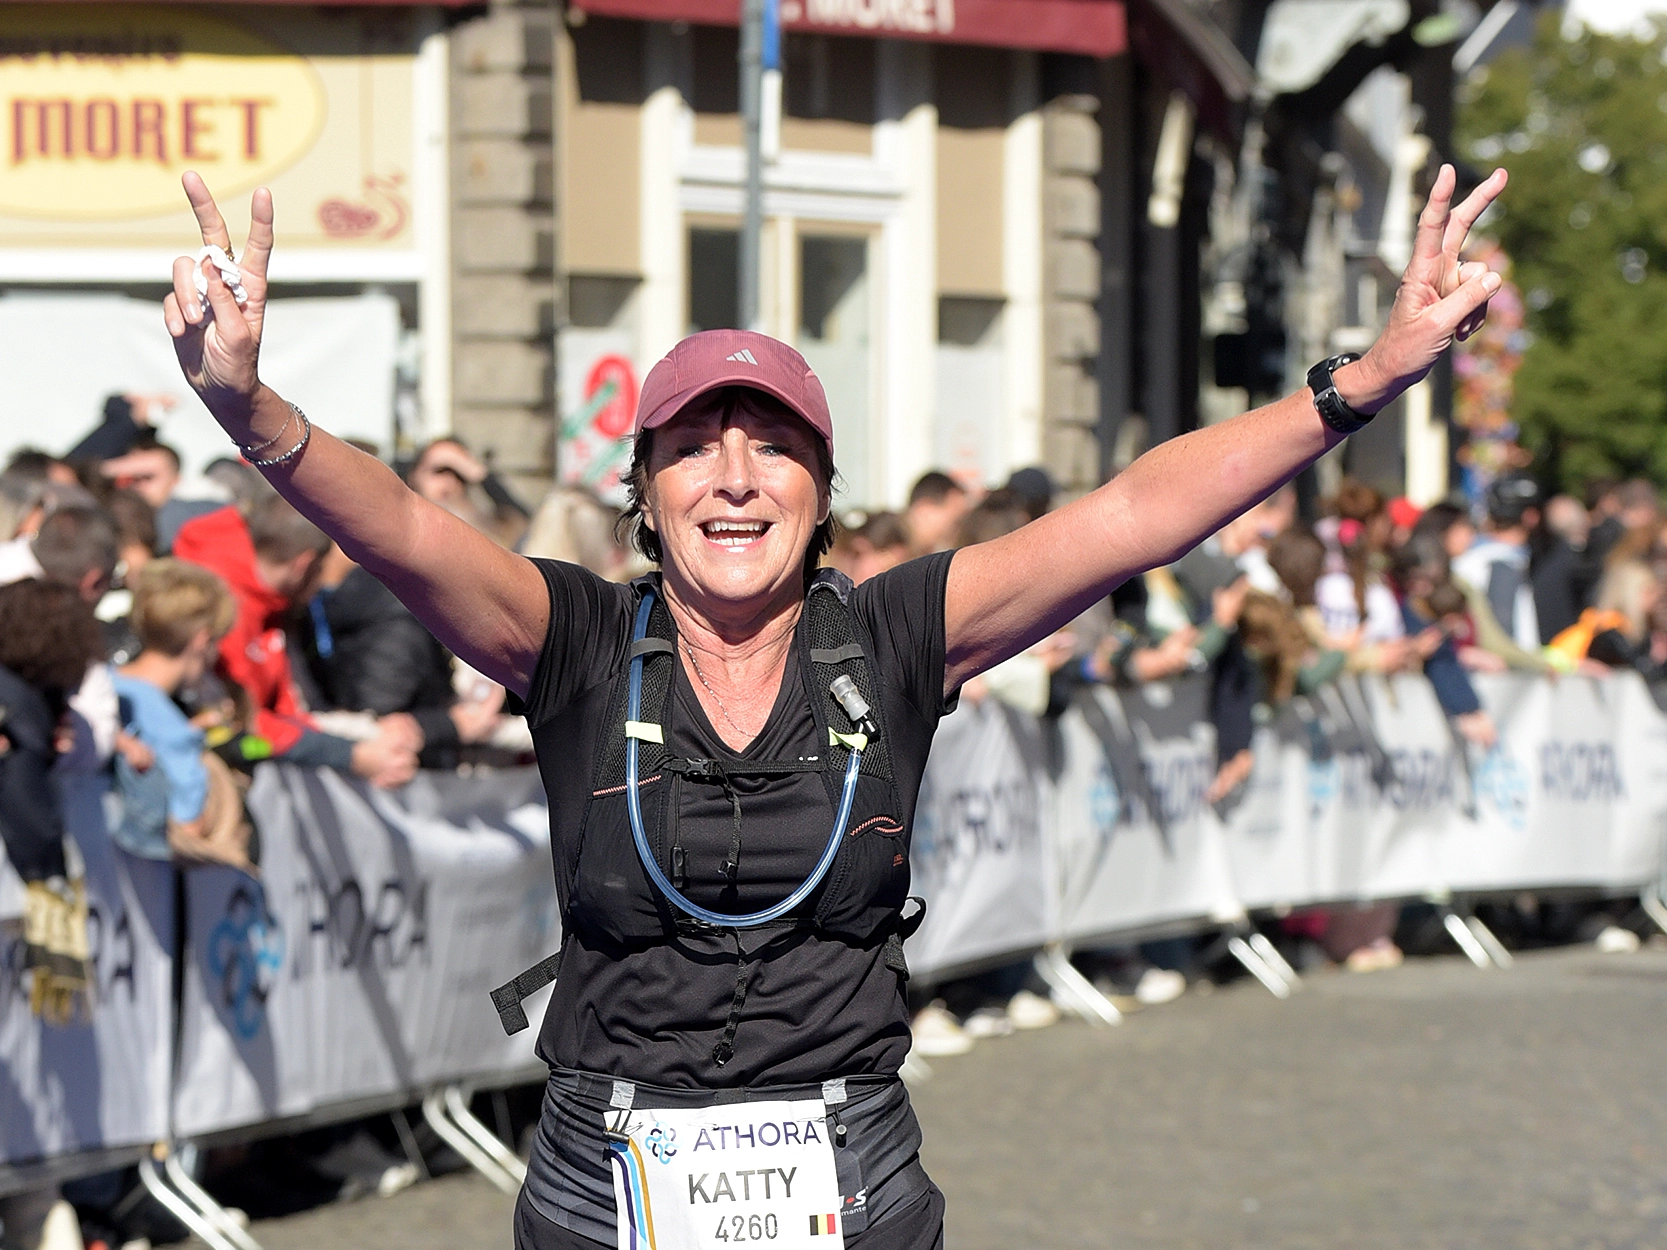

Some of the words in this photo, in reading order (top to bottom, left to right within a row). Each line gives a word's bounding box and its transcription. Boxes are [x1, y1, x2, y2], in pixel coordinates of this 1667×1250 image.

[10, 97, 276, 167] MORET
[693, 1121, 821, 1151] ATHORA
[688, 1167, 797, 1204] KATTY
[715, 1213, 778, 1242] 4260
